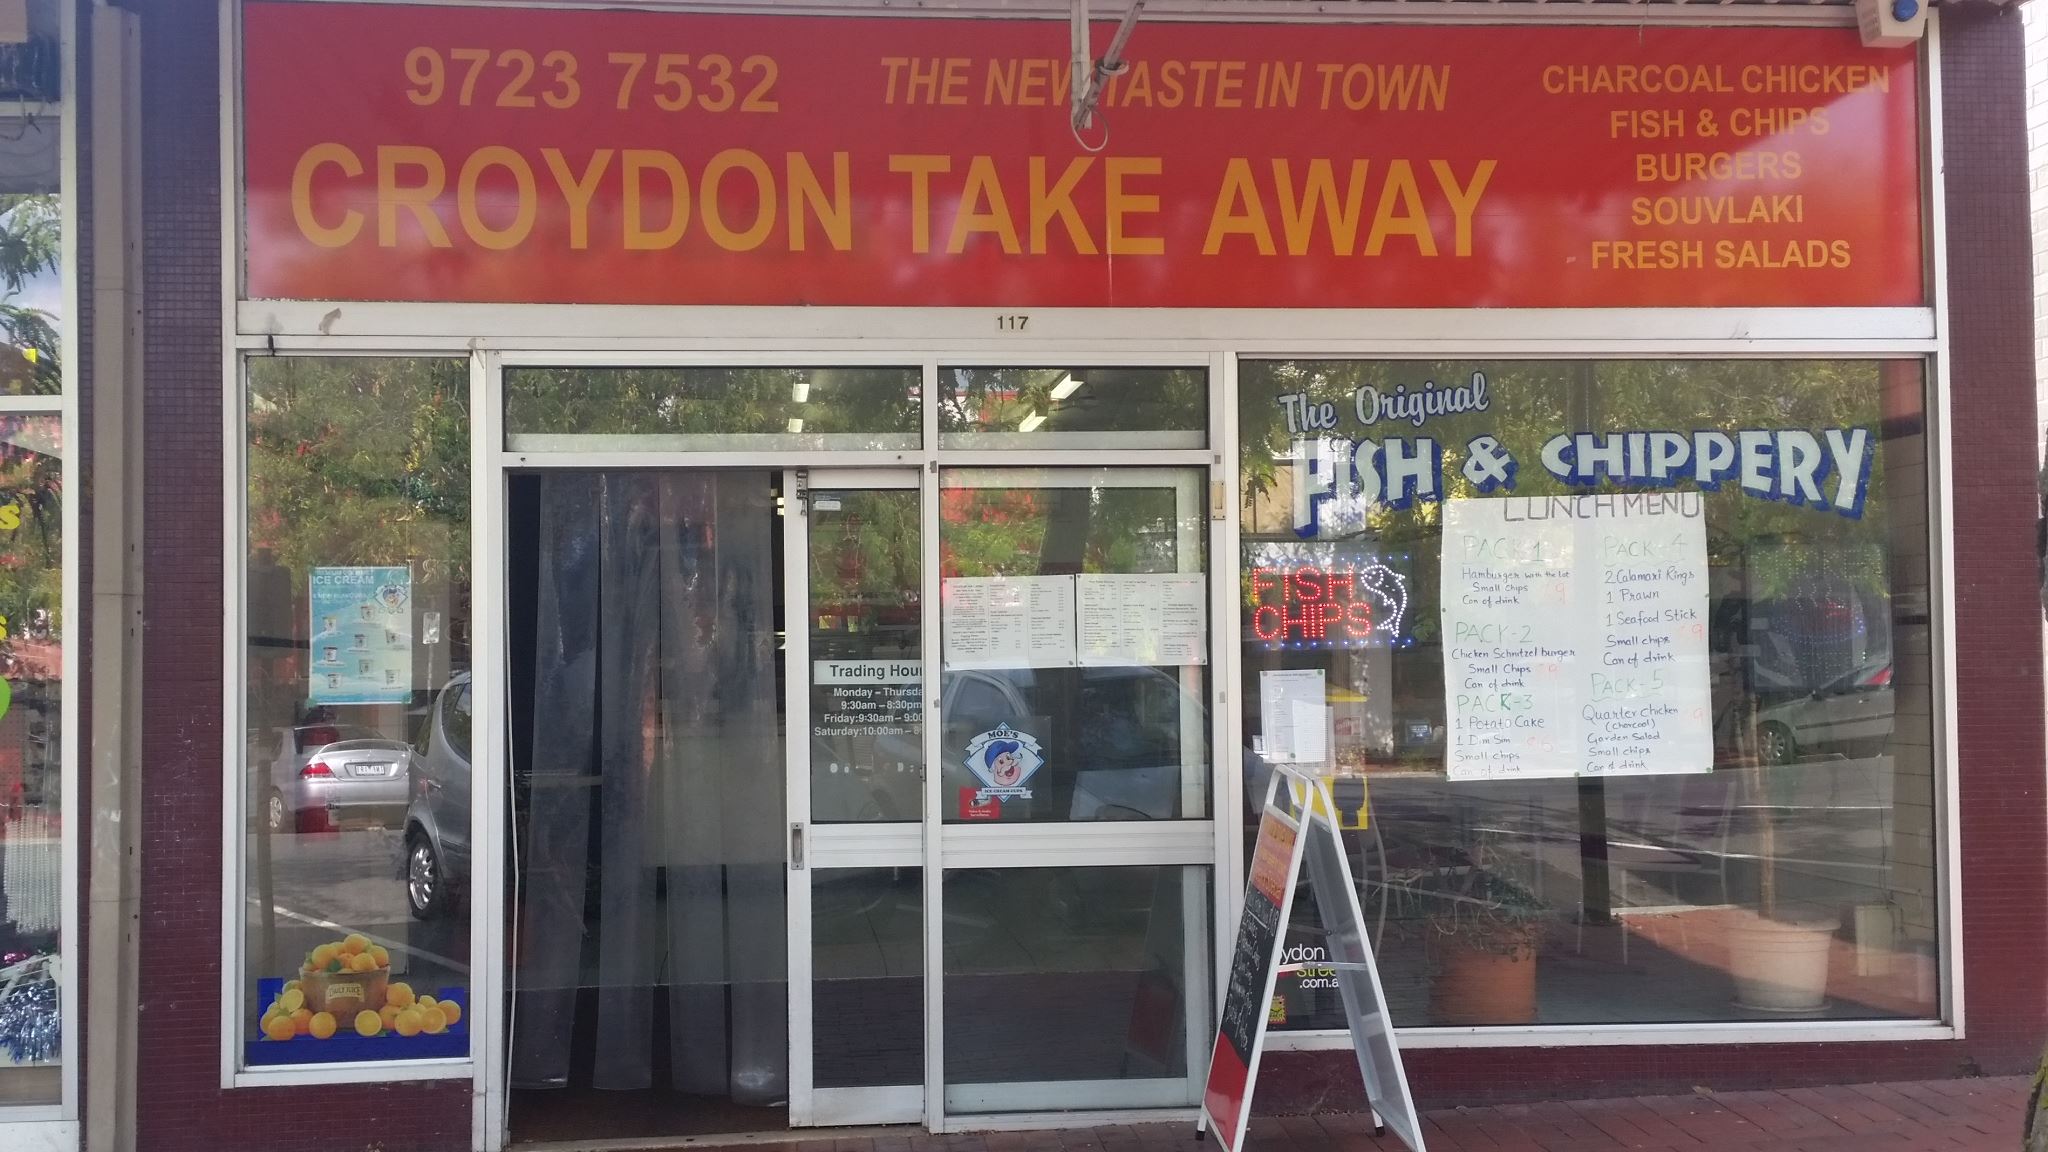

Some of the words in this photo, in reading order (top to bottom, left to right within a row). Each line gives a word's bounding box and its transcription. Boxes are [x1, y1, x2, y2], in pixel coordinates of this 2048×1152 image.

[404, 46, 580, 109] 9723
[608, 52, 779, 113] 7532
[881, 57, 971, 105] THE
[1256, 62, 1302, 109] IN
[1316, 63, 1450, 111] TOWN
[1543, 65, 1734, 94] CHARCOAL
[1742, 65, 1889, 94] CHICKEN
[1611, 109, 1684, 138] FISH
[1697, 110, 1719, 137] &
[1730, 106, 1830, 136] CHIPS
[1636, 152, 1801, 182] BURGERS
[292, 143, 852, 251] CROYDON
[889, 154, 1164, 255] TAKE
[1202, 158, 1498, 257] AWAY
[1631, 195, 1803, 226] SOUVLAKI
[1592, 241, 1702, 269] FRESH
[1715, 239, 1851, 268] SALADS
[997, 316, 1029, 330] 117
[1278, 392, 1337, 433] The
[1356, 371, 1489, 427] Original
[1292, 437, 1445, 537] FISH
[1462, 434, 1518, 493] &
[1541, 428, 1874, 520] CHIPPERY
[1504, 494, 1615, 521] LUNCH
[1624, 492, 1700, 518] MENU
[313, 575, 331, 585] ICE
[334, 575, 374, 585] CREAM
[1462, 568, 1520, 583] Hamburger
[1605, 570, 1616, 584] 2
[1617, 569, 1662, 584] Calamari
[1666, 566, 1695, 586] Rings
[1253, 566, 1355, 604] FISH
[1473, 582, 1501, 593] Small
[1482, 595, 1493, 609] of
[1495, 595, 1520, 605] drink
[1607, 591, 1614, 604] 1
[1620, 588, 1660, 602] Prawn
[1254, 602, 1373, 640] CHIPS
[1606, 614, 1614, 626] 1
[1617, 610, 1660, 626] Seafood
[1665, 608, 1697, 621] Stick
[1605, 634, 1638, 648] Small
[1452, 648, 1489, 660] Chicken
[1493, 646, 1538, 659] Schnitzel
[1627, 652, 1639, 668] of
[1643, 651, 1677, 663] drink
[830, 664, 885, 680] Trading
[1468, 664, 1498, 674] Small
[1488, 678, 1498, 692] of
[1501, 678, 1525, 688] drink
[833, 688, 873, 699] Monday
[883, 688, 922, 697] Thursda
[841, 701, 877, 710] 9:30am
[1455, 718, 1463, 730] 1
[1469, 715, 1512, 730] Potato
[1515, 715, 1545, 729] Cake
[1583, 704, 1637, 725] Quarter
[988, 730, 1019, 739] MOE'S
[1456, 735, 1463, 746] 1
[1587, 732, 1629, 744] Garden
[1632, 731, 1661, 741] Salad
[1455, 750, 1488, 762] Small
[1589, 747, 1619, 757] Small
[1619, 760, 1648, 770] drink
[1281, 944, 1325, 965] ydon
[1300, 978, 1339, 989] .com.a
